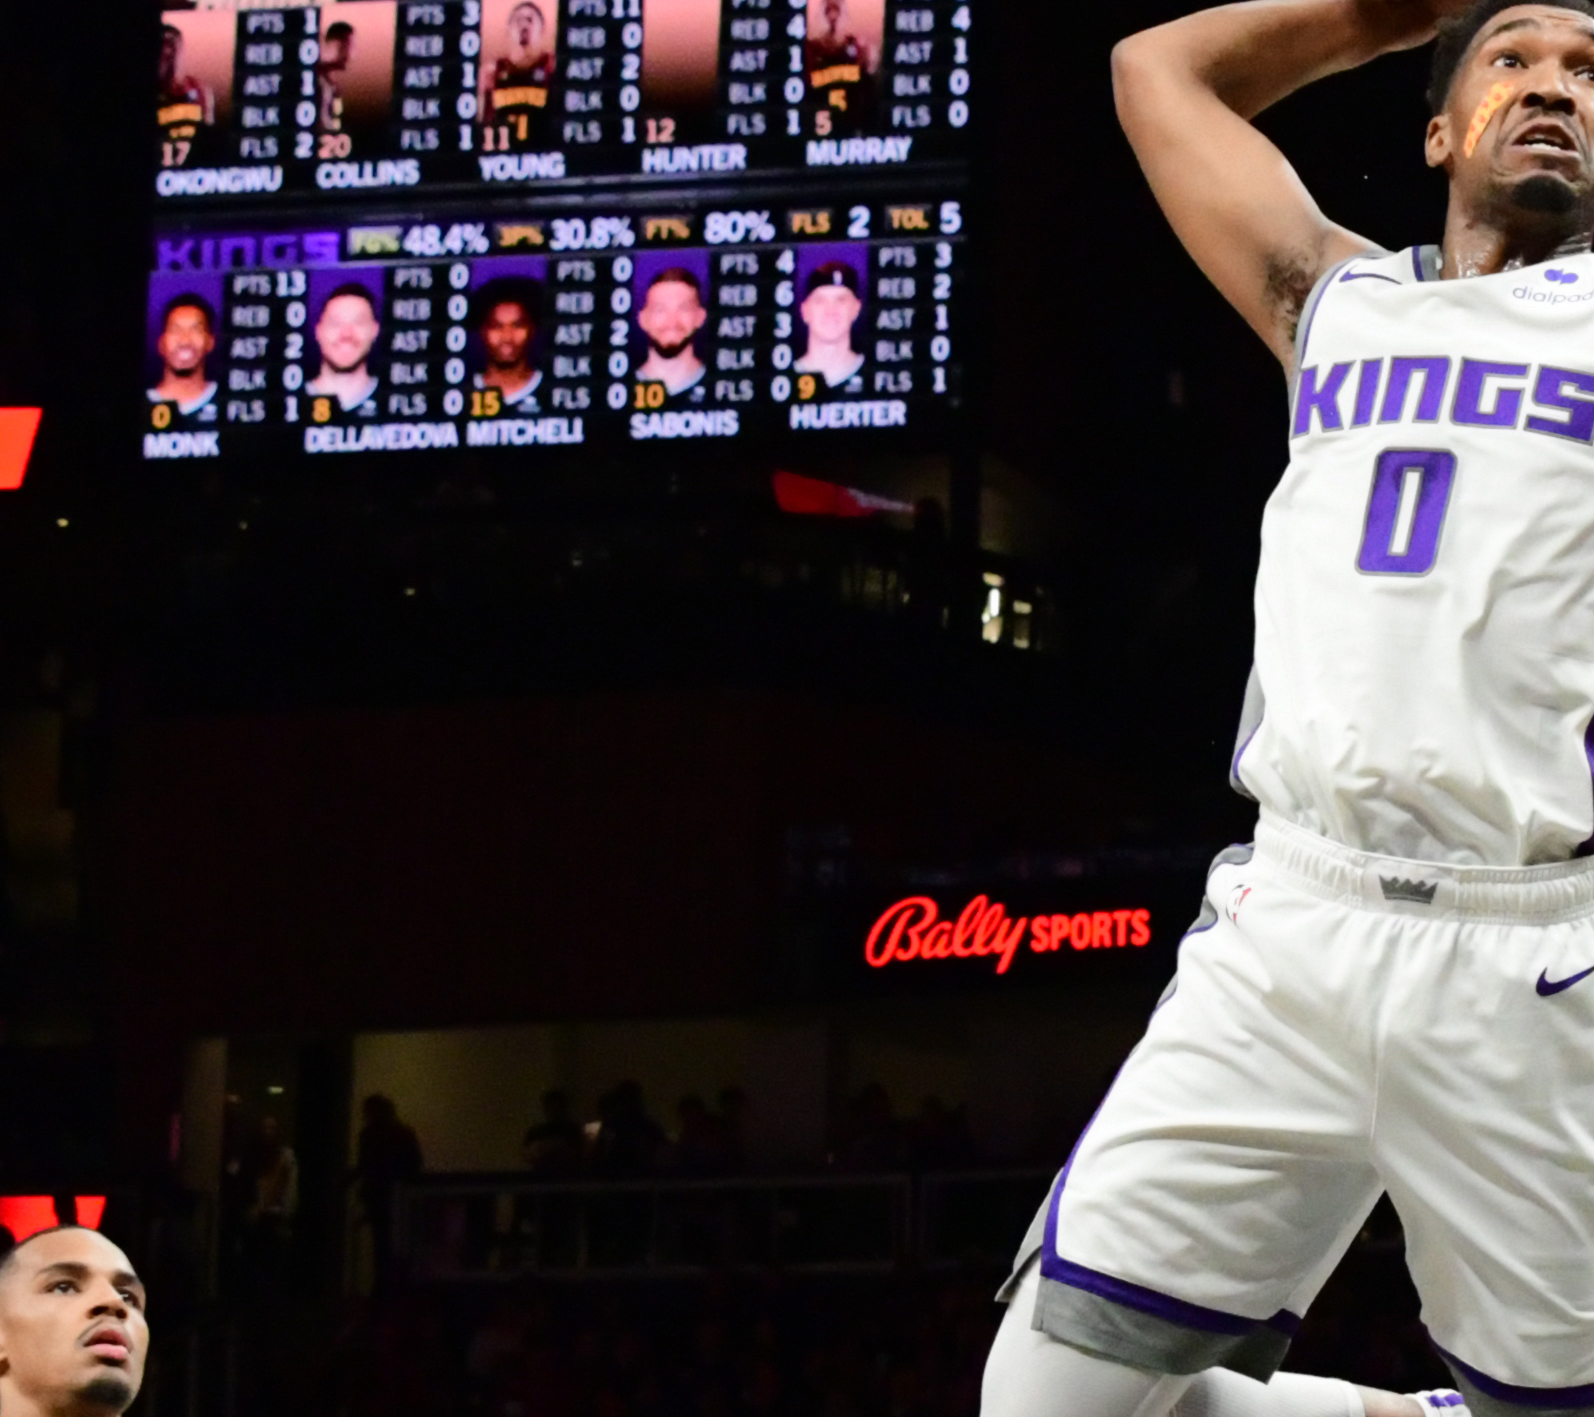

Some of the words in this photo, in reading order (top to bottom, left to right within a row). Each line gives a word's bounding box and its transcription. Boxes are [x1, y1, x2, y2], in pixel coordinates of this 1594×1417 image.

[303, 7, 318, 33] 1
[462, 0, 480, 26] 3
[459, 31, 481, 58] 0
[621, 22, 642, 49] 0
[299, 39, 319, 65] 0
[462, 63, 476, 88] 1
[620, 53, 641, 81] 2
[301, 69, 315, 96] 1
[457, 93, 478, 120] 0
[619, 84, 640, 113] 0
[295, 101, 317, 128] 0
[815, 110, 832, 135] 5
[621, 116, 636, 143] 1
[646, 117, 676, 144] 12
[162, 140, 192, 167] 17
[294, 132, 314, 159] 2
[317, 133, 352, 159] 20
[642, 143, 747, 174] HUNTER
[806, 136, 913, 166] MURRAY
[316, 158, 420, 188] COLLINS
[479, 152, 566, 181] YOUNG
[156, 165, 283, 197] OKONGWU
[703, 211, 776, 245] 80%
[791, 212, 831, 234] FLS
[847, 205, 871, 239] 2
[890, 208, 930, 231] TOL
[939, 201, 962, 234] 5
[402, 223, 491, 256] 48.4%
[549, 216, 636, 250] 30.8%
[775, 248, 796, 274] 4
[934, 241, 953, 268] 3
[275, 269, 306, 297] 13
[448, 263, 470, 290] 0
[611, 256, 633, 282] 0
[774, 280, 795, 308] 6
[932, 272, 952, 300] 2
[1512, 285, 1594, 305] dialpad
[285, 301, 306, 328] 0
[446, 294, 469, 321] 0
[610, 287, 631, 314] 0
[774, 311, 793, 340] 3
[934, 303, 950, 331] 1
[284, 332, 304, 360] 2
[445, 325, 467, 353] 0
[609, 318, 630, 347] 2
[772, 343, 793, 371] 0
[930, 334, 951, 362] 0
[282, 364, 303, 391] 0
[444, 357, 465, 384] 0
[608, 349, 629, 378] 0
[770, 374, 791, 402] 0
[797, 374, 816, 400] 9
[932, 365, 947, 394] 1
[283, 395, 299, 422] 1
[442, 388, 464, 416] 0
[470, 390, 501, 417] 15
[607, 381, 628, 409] 0
[634, 382, 665, 409] 10
[151, 403, 171, 429] 0
[312, 396, 332, 423] 8
[789, 398, 907, 430] HUERTER
[305, 422, 459, 454] DELLAVEDOVA
[466, 417, 584, 447] MITCHELL
[630, 409, 740, 440] SABONIS
[143, 432, 220, 459] MONK
[1355, 446, 1457, 578] 0
[864, 894, 1027, 975] Bally
[1030, 908, 1152, 953] SPORTS
